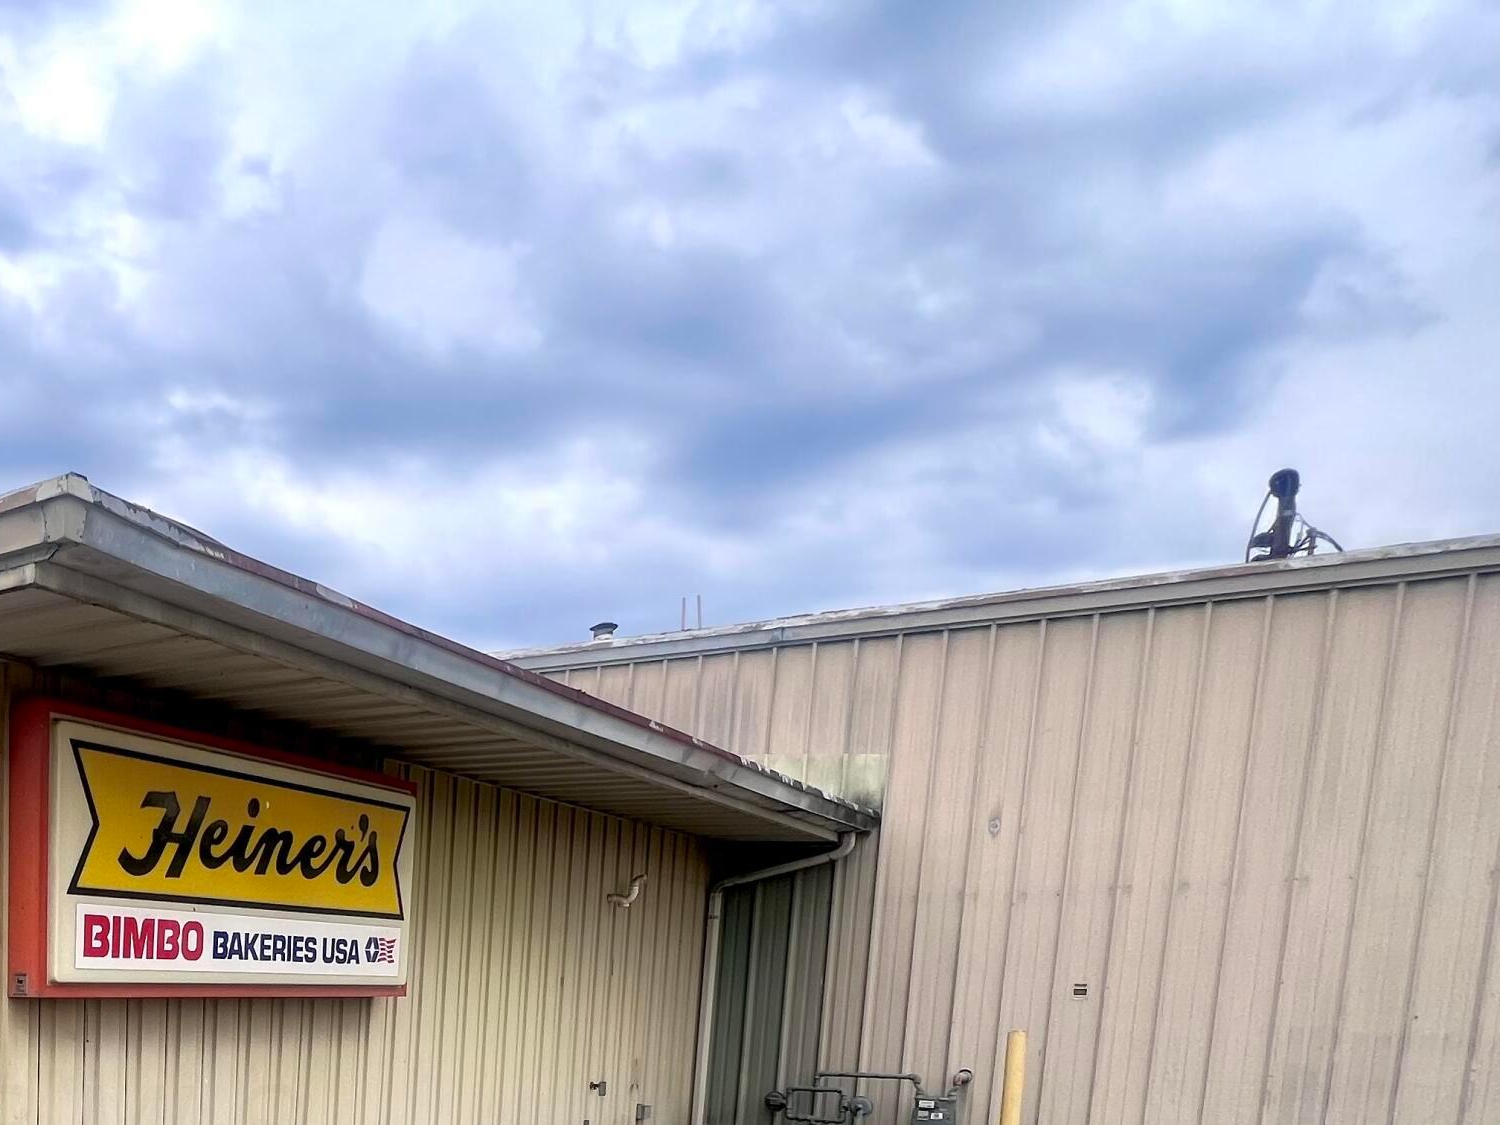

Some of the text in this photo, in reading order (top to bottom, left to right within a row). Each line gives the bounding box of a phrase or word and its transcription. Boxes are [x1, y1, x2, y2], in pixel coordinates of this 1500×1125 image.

[117, 790, 380, 888] Heiner's
[83, 914, 361, 965] BIMBO BAKERIES USA
